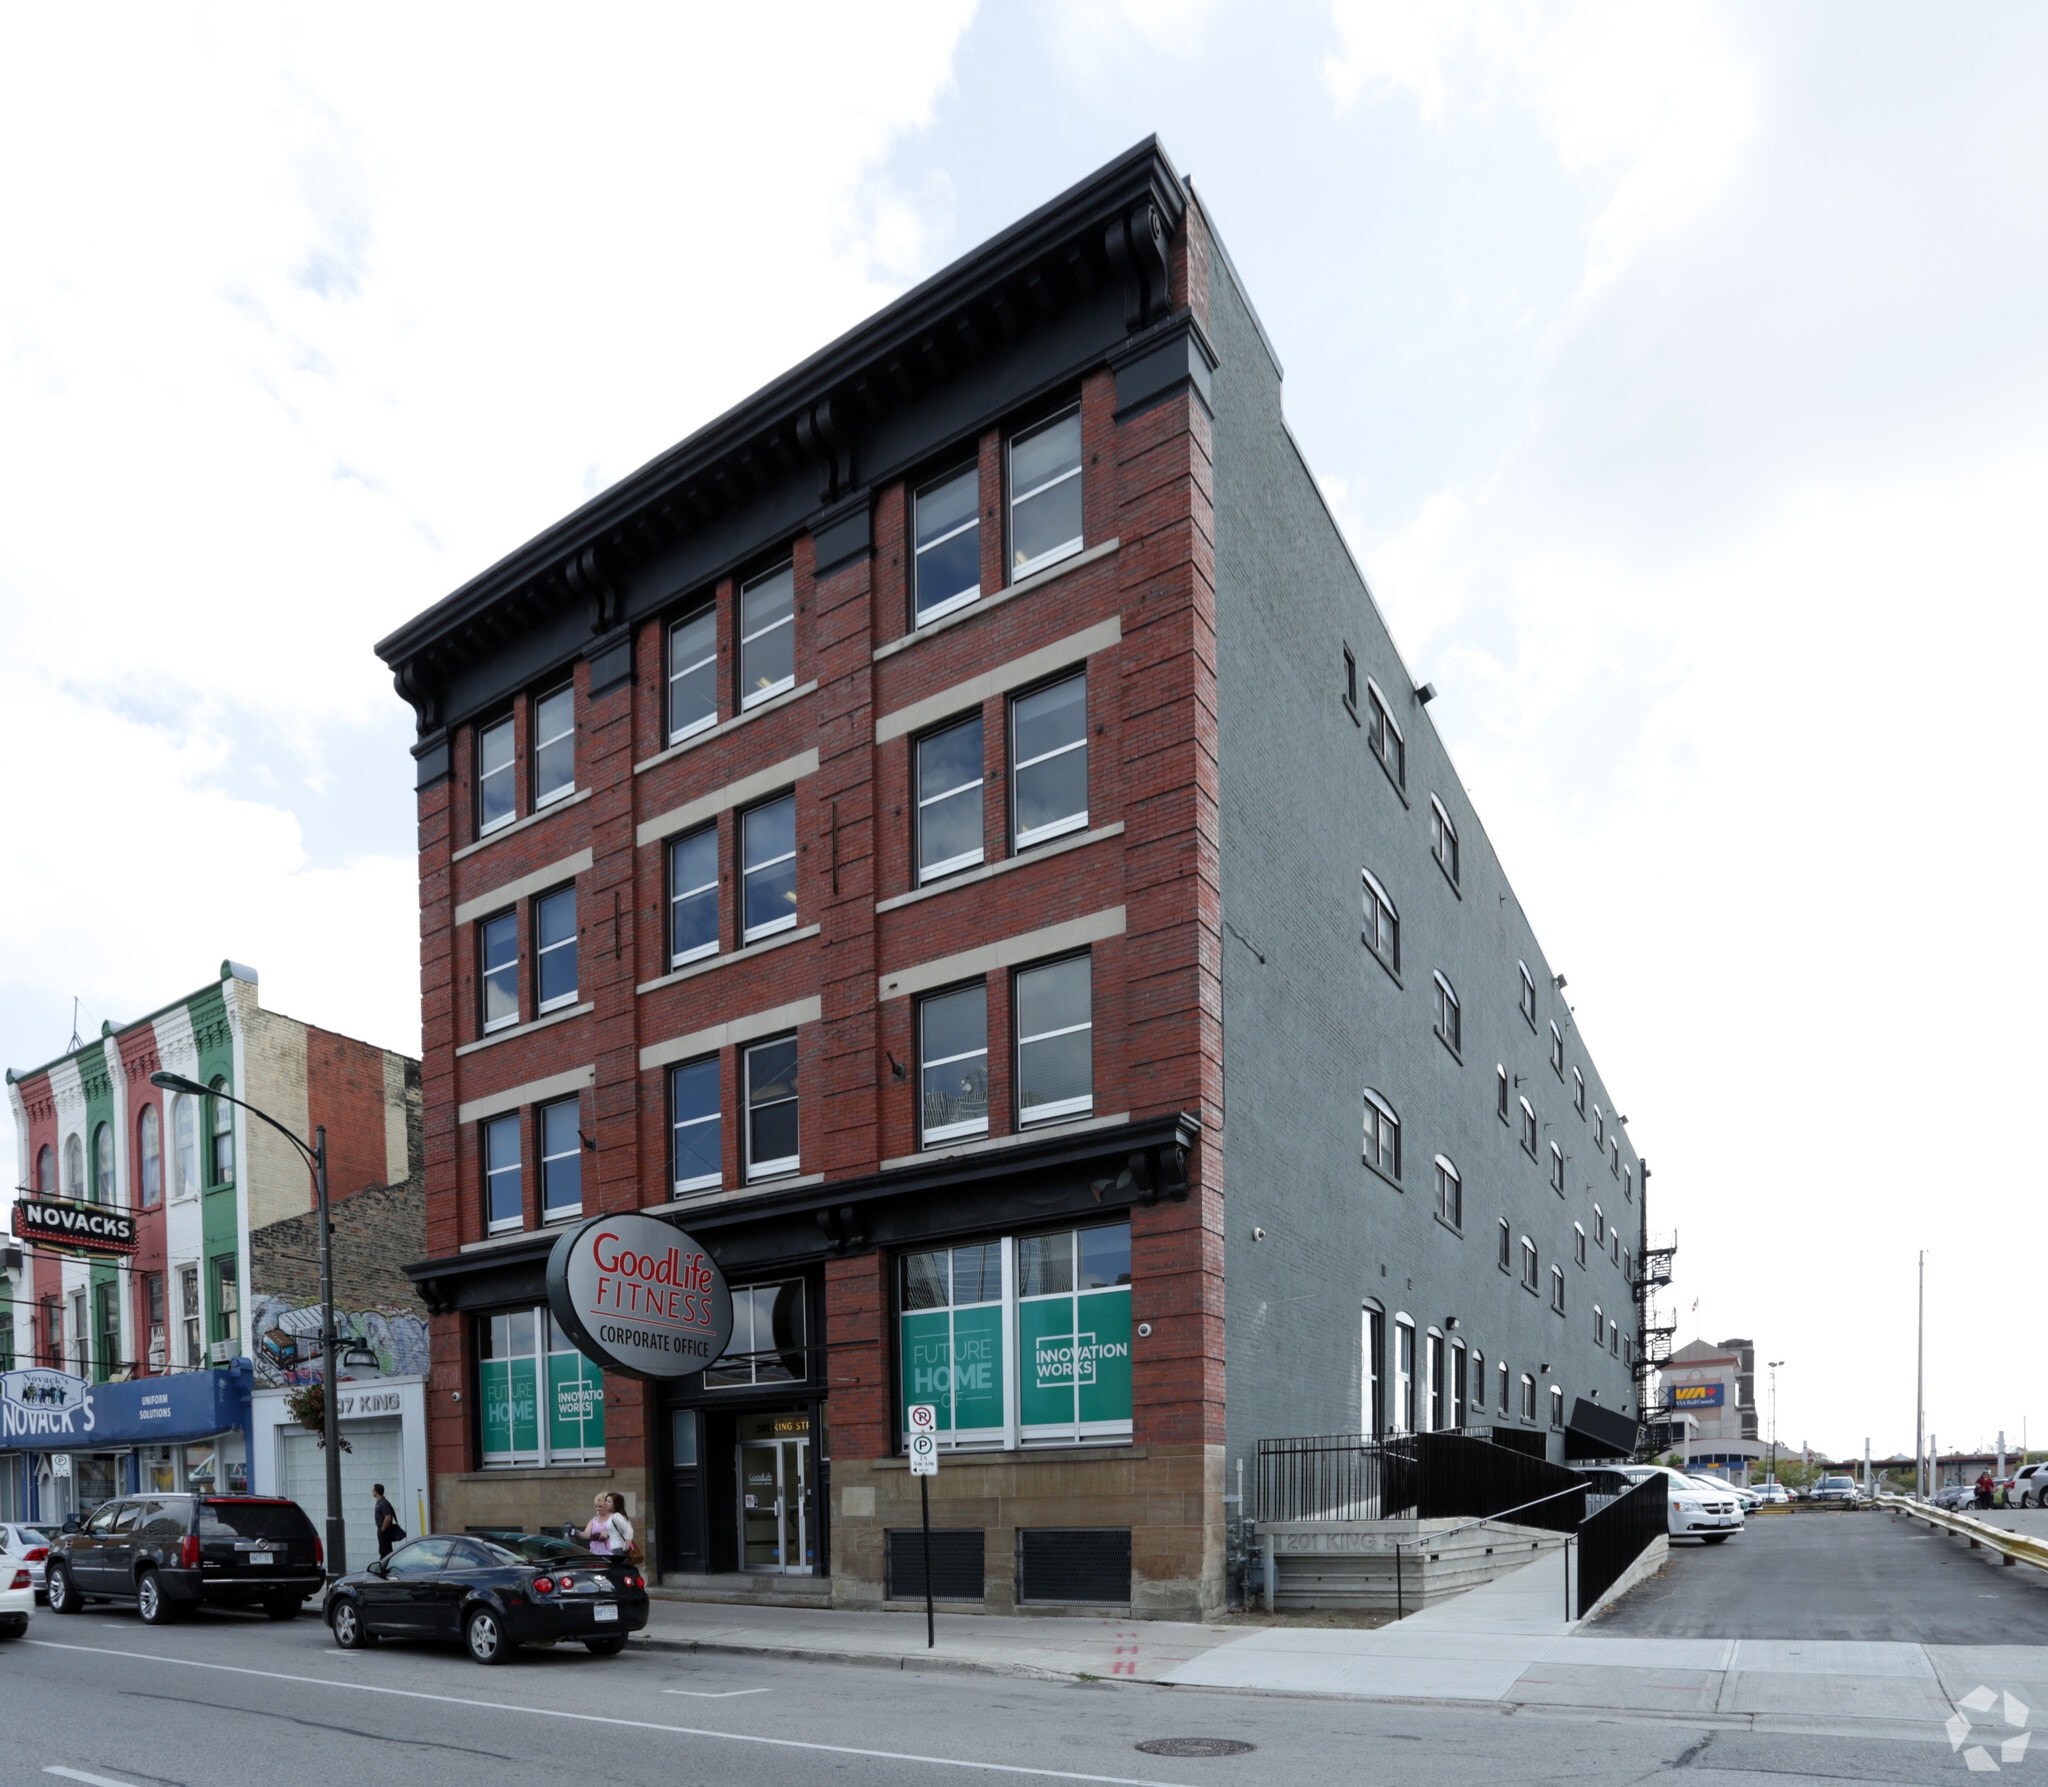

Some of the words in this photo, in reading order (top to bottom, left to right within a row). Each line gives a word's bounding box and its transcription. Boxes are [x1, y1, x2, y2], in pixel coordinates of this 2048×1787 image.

[27, 1204, 131, 1238] NOVACKS
[593, 1232, 712, 1294] GoodLife
[597, 1276, 711, 1326] FITNESS
[600, 1325, 670, 1352] CORPORATE
[673, 1337, 709, 1358] OFFICE
[914, 1338, 992, 1364] FUTURE
[1036, 1342, 1128, 1364] INNOVATION
[915, 1362, 992, 1393] HOME
[1037, 1361, 1093, 1377] WORKS
[23, 1373, 69, 1386] Novack's
[141, 1394, 168, 1406] UNIFORM
[488, 1382, 533, 1400] FUTURE
[940, 1391, 965, 1408] OF
[1676, 1387, 1706, 1400] VIA
[360, 1392, 400, 1412] KING
[489, 1400, 534, 1423] HOME
[559, 1402, 591, 1413] WORKS
[3, 1395, 96, 1438] NOVACKS
[139, 1408, 171, 1420] SOLUTIONS
[1287, 1534, 1318, 1551] 201
[1326, 1533, 1377, 1551] KING
